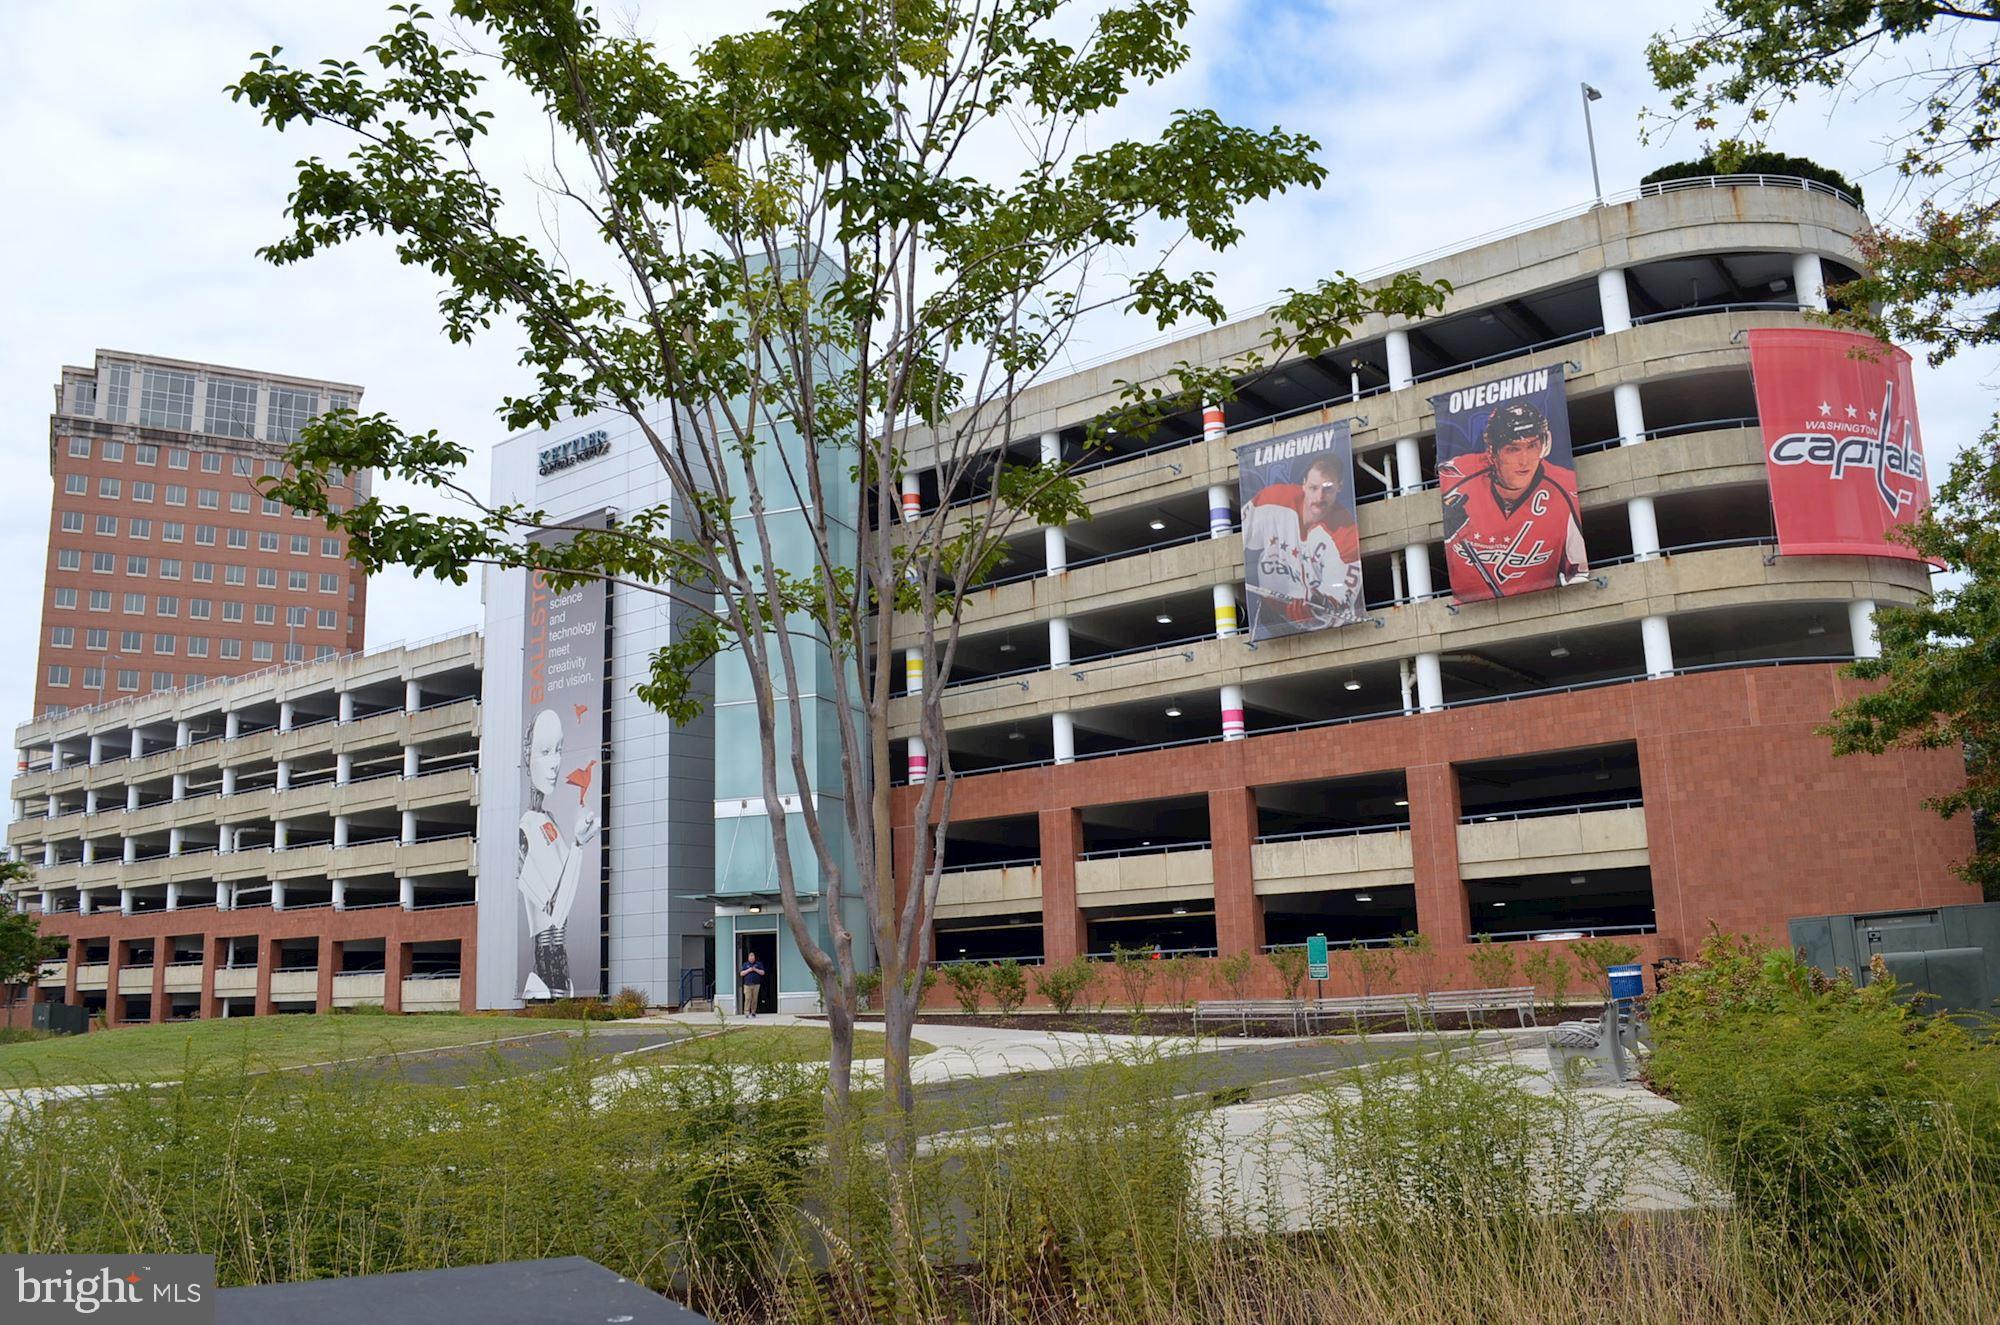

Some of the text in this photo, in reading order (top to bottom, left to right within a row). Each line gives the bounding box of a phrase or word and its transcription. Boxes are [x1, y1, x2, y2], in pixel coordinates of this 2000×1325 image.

[1449, 369, 1548, 413] OVECHKIN
[1805, 420, 1878, 436] WASHINGTON
[1254, 429, 1334, 467] LANGWAY
[1531, 490, 1549, 516] C
[550, 591, 583, 610] science
[530, 548, 548, 704] BALLSTO
[549, 611, 566, 626] and
[549, 621, 597, 641] technology
[548, 643, 570, 658] meet
[548, 656, 587, 675] creativity
[547, 672, 594, 692] and vision.
